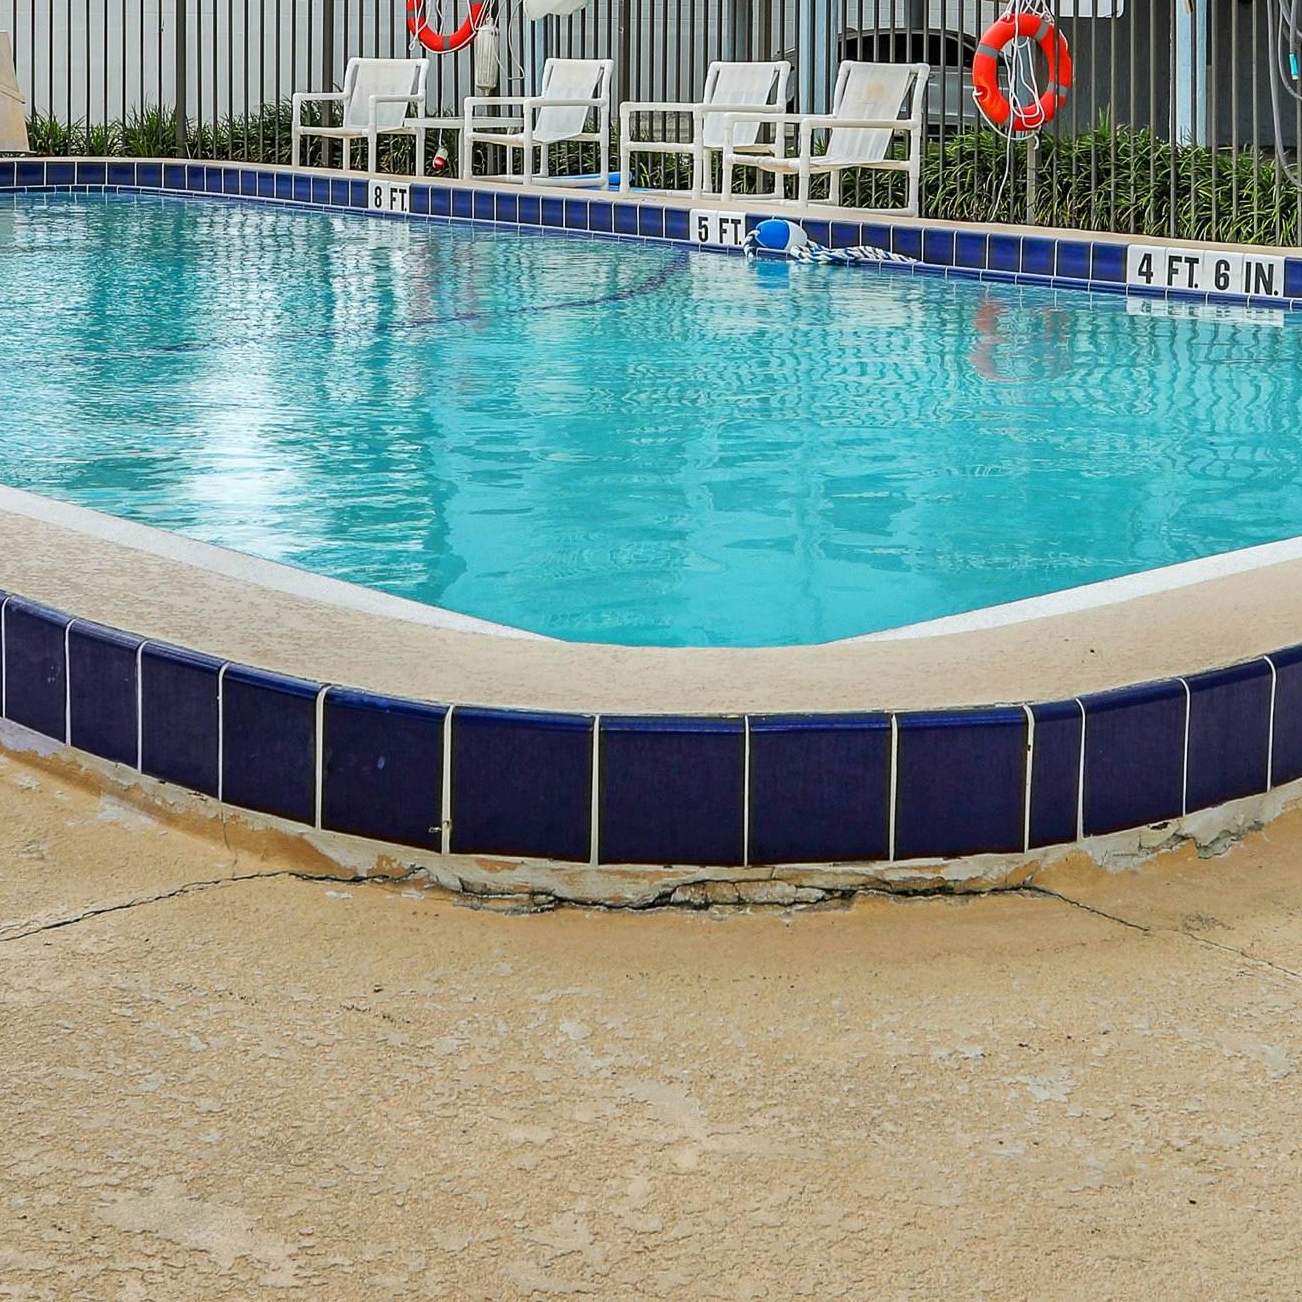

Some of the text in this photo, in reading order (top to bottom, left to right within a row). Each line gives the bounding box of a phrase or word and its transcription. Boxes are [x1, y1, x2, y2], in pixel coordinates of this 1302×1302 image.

[374, 186, 407, 212] 8 FT.
[698, 216, 742, 245] 5 FT.
[1138, 253, 1279, 296] 4 FT. 6 IN.
